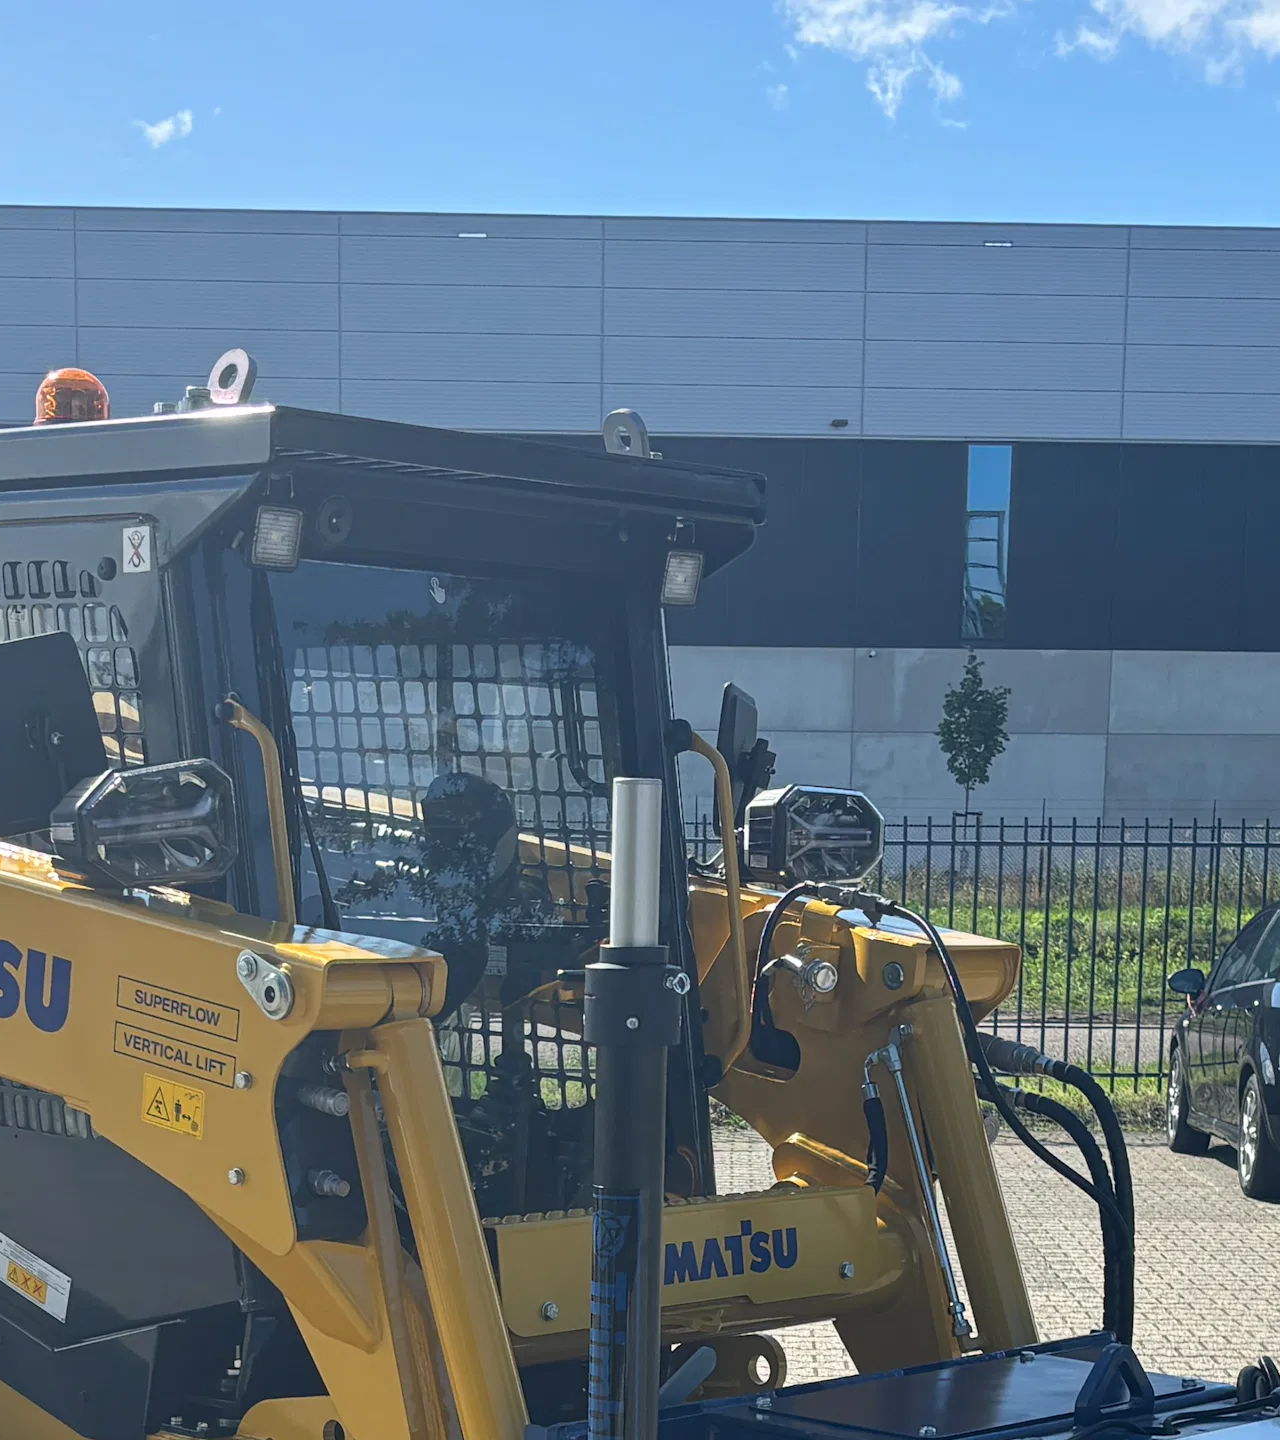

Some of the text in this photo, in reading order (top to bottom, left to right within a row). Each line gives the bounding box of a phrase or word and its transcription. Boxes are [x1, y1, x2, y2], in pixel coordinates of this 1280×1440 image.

[134, 989, 220, 1026] SUPERFLOW
[124, 1032, 227, 1075] VERTICAL LIFT
[664, 1220, 798, 1285] MATSU
